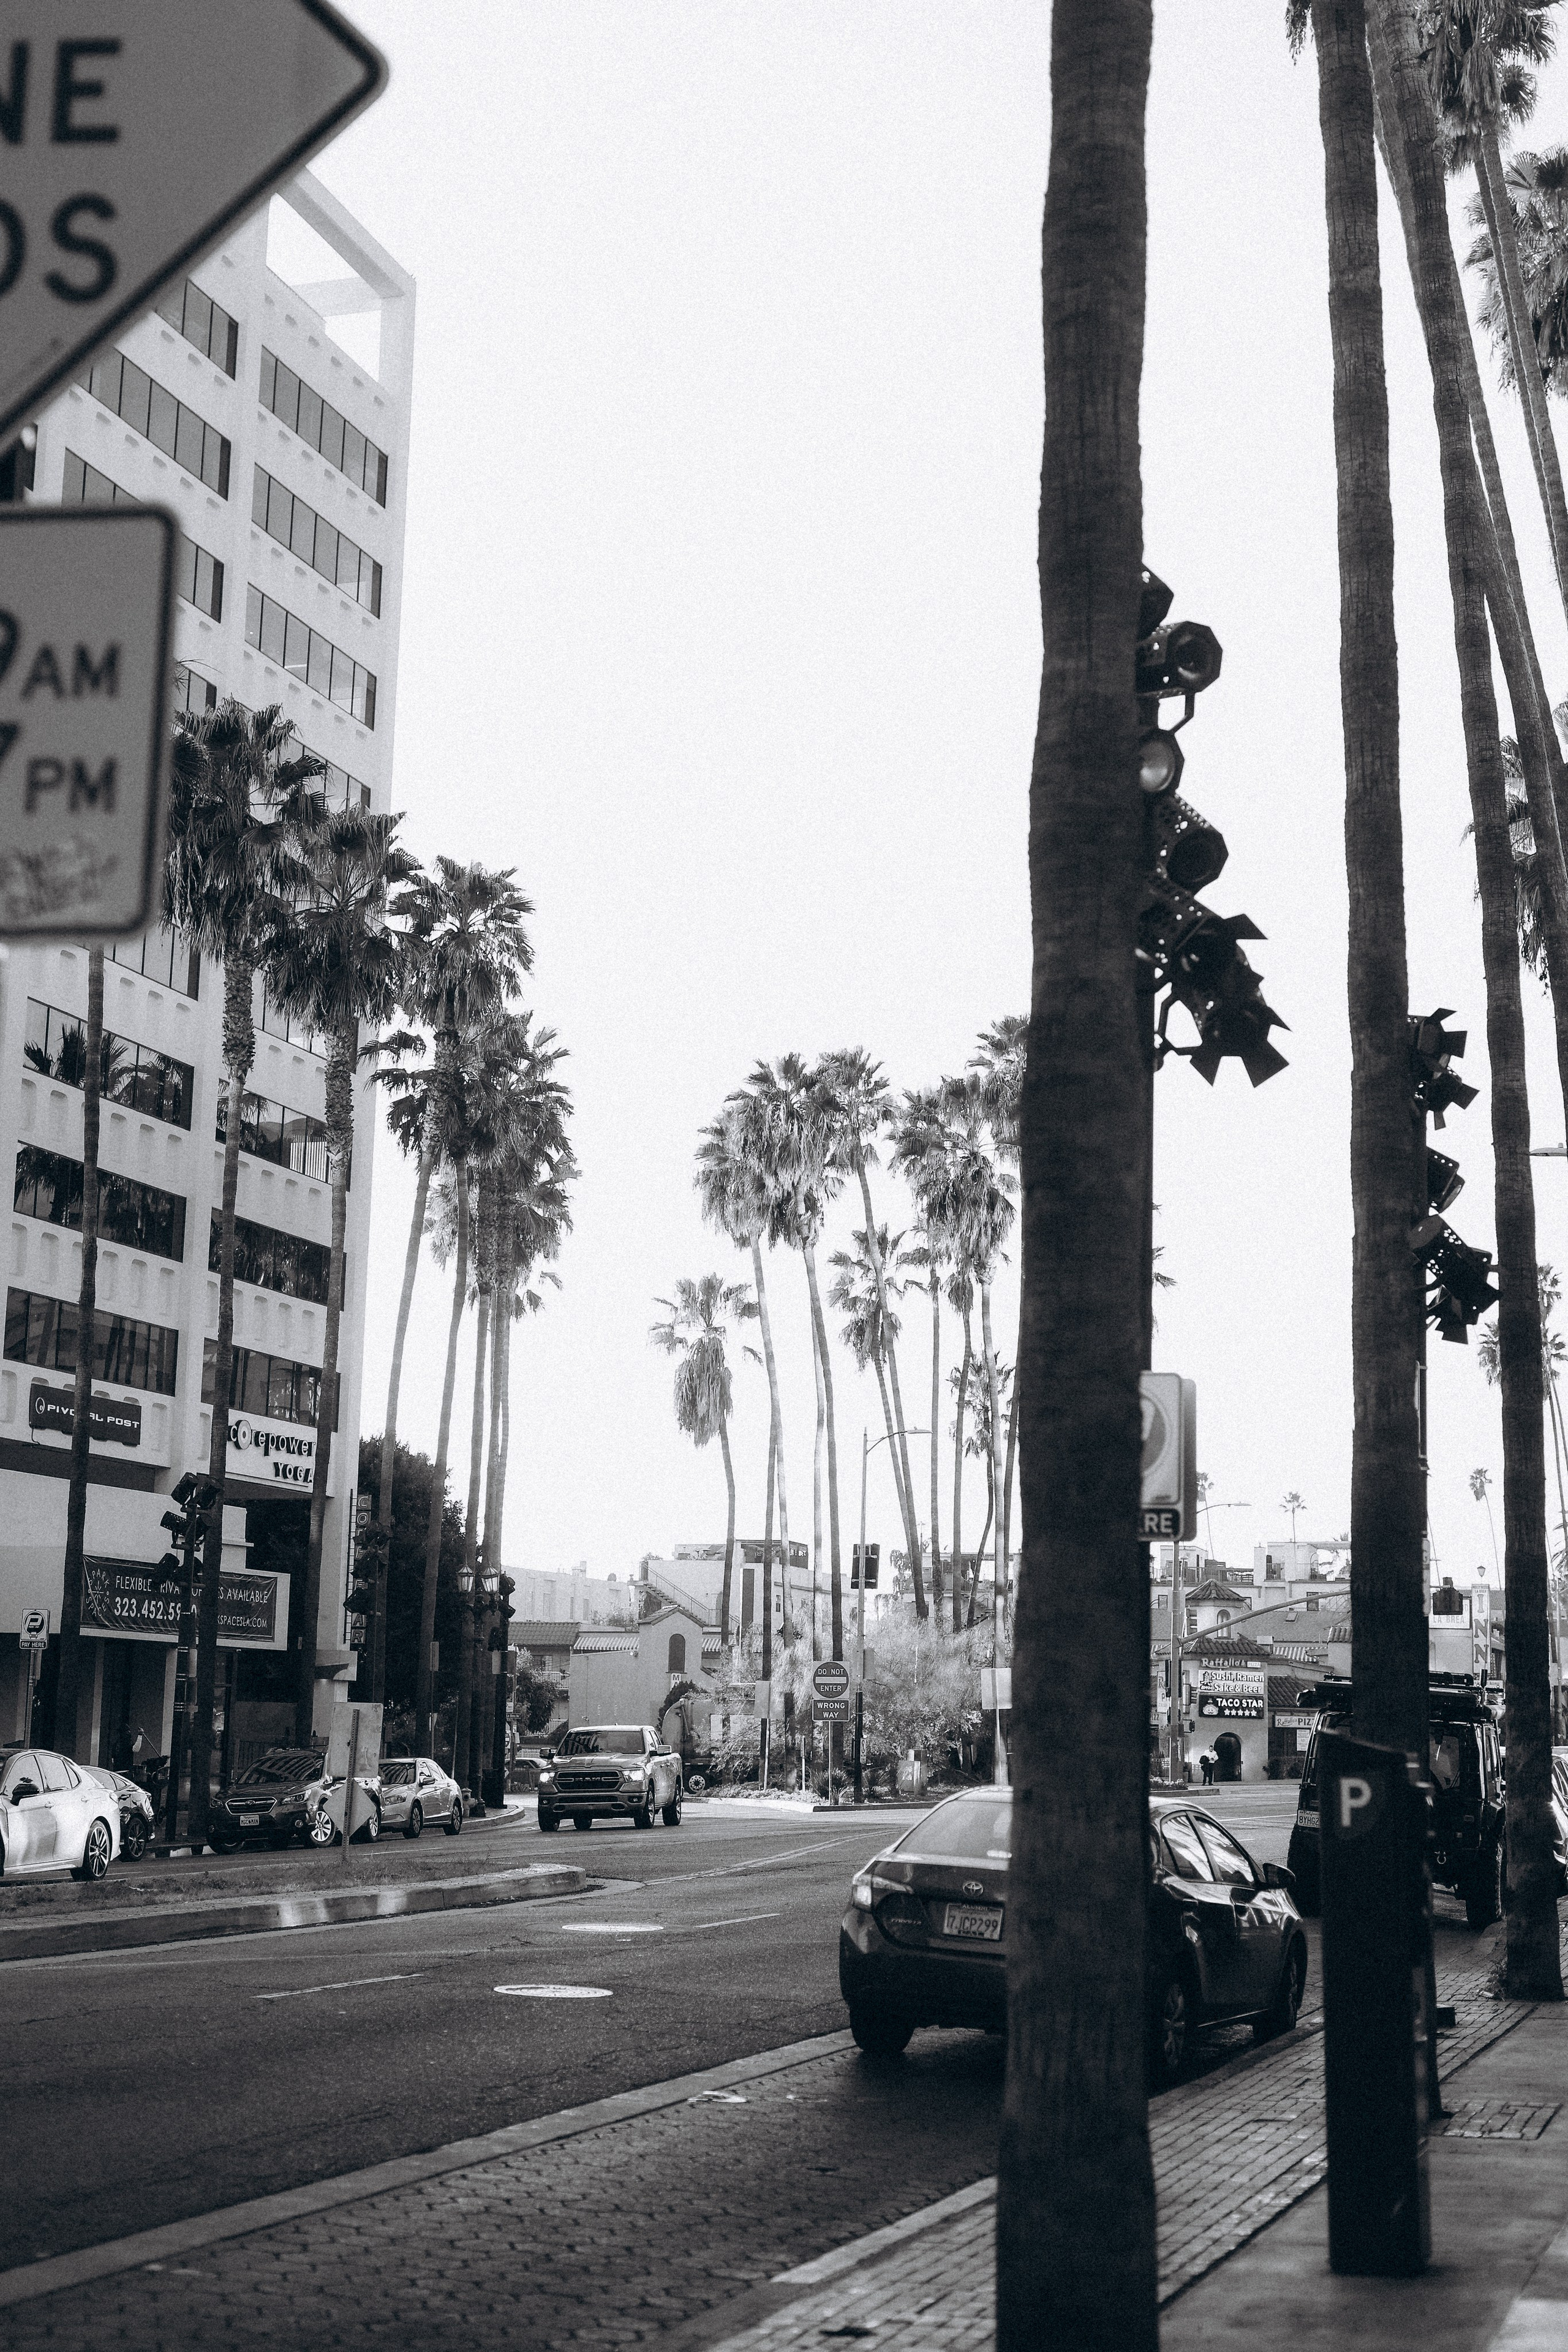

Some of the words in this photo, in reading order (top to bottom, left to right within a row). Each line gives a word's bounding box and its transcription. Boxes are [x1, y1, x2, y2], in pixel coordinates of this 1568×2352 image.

[47, 1404, 104, 1422] PIVOAL
[107, 1416, 140, 1428] POST
[274, 1461, 314, 1483] YOGA
[116, 1575, 152, 1592] FLEXIBLE
[227, 1588, 268, 1603] AVAILABLE
[114, 1597, 197, 1621] 323.452.59
[1211, 1672, 1237, 1682] Sushi,
[1237, 1672, 1265, 1682] Ramen
[1213, 1683, 1234, 1692] Sake
[1242, 1684, 1262, 1693] Beer
[1216, 1698, 1240, 1707] TACO
[1242, 1699, 1264, 1708] STAR
[1340, 1777, 1373, 1827] P
[1299, 1815, 1320, 1825] 8YHG2
[949, 1915, 998, 1933] 7JCP299
